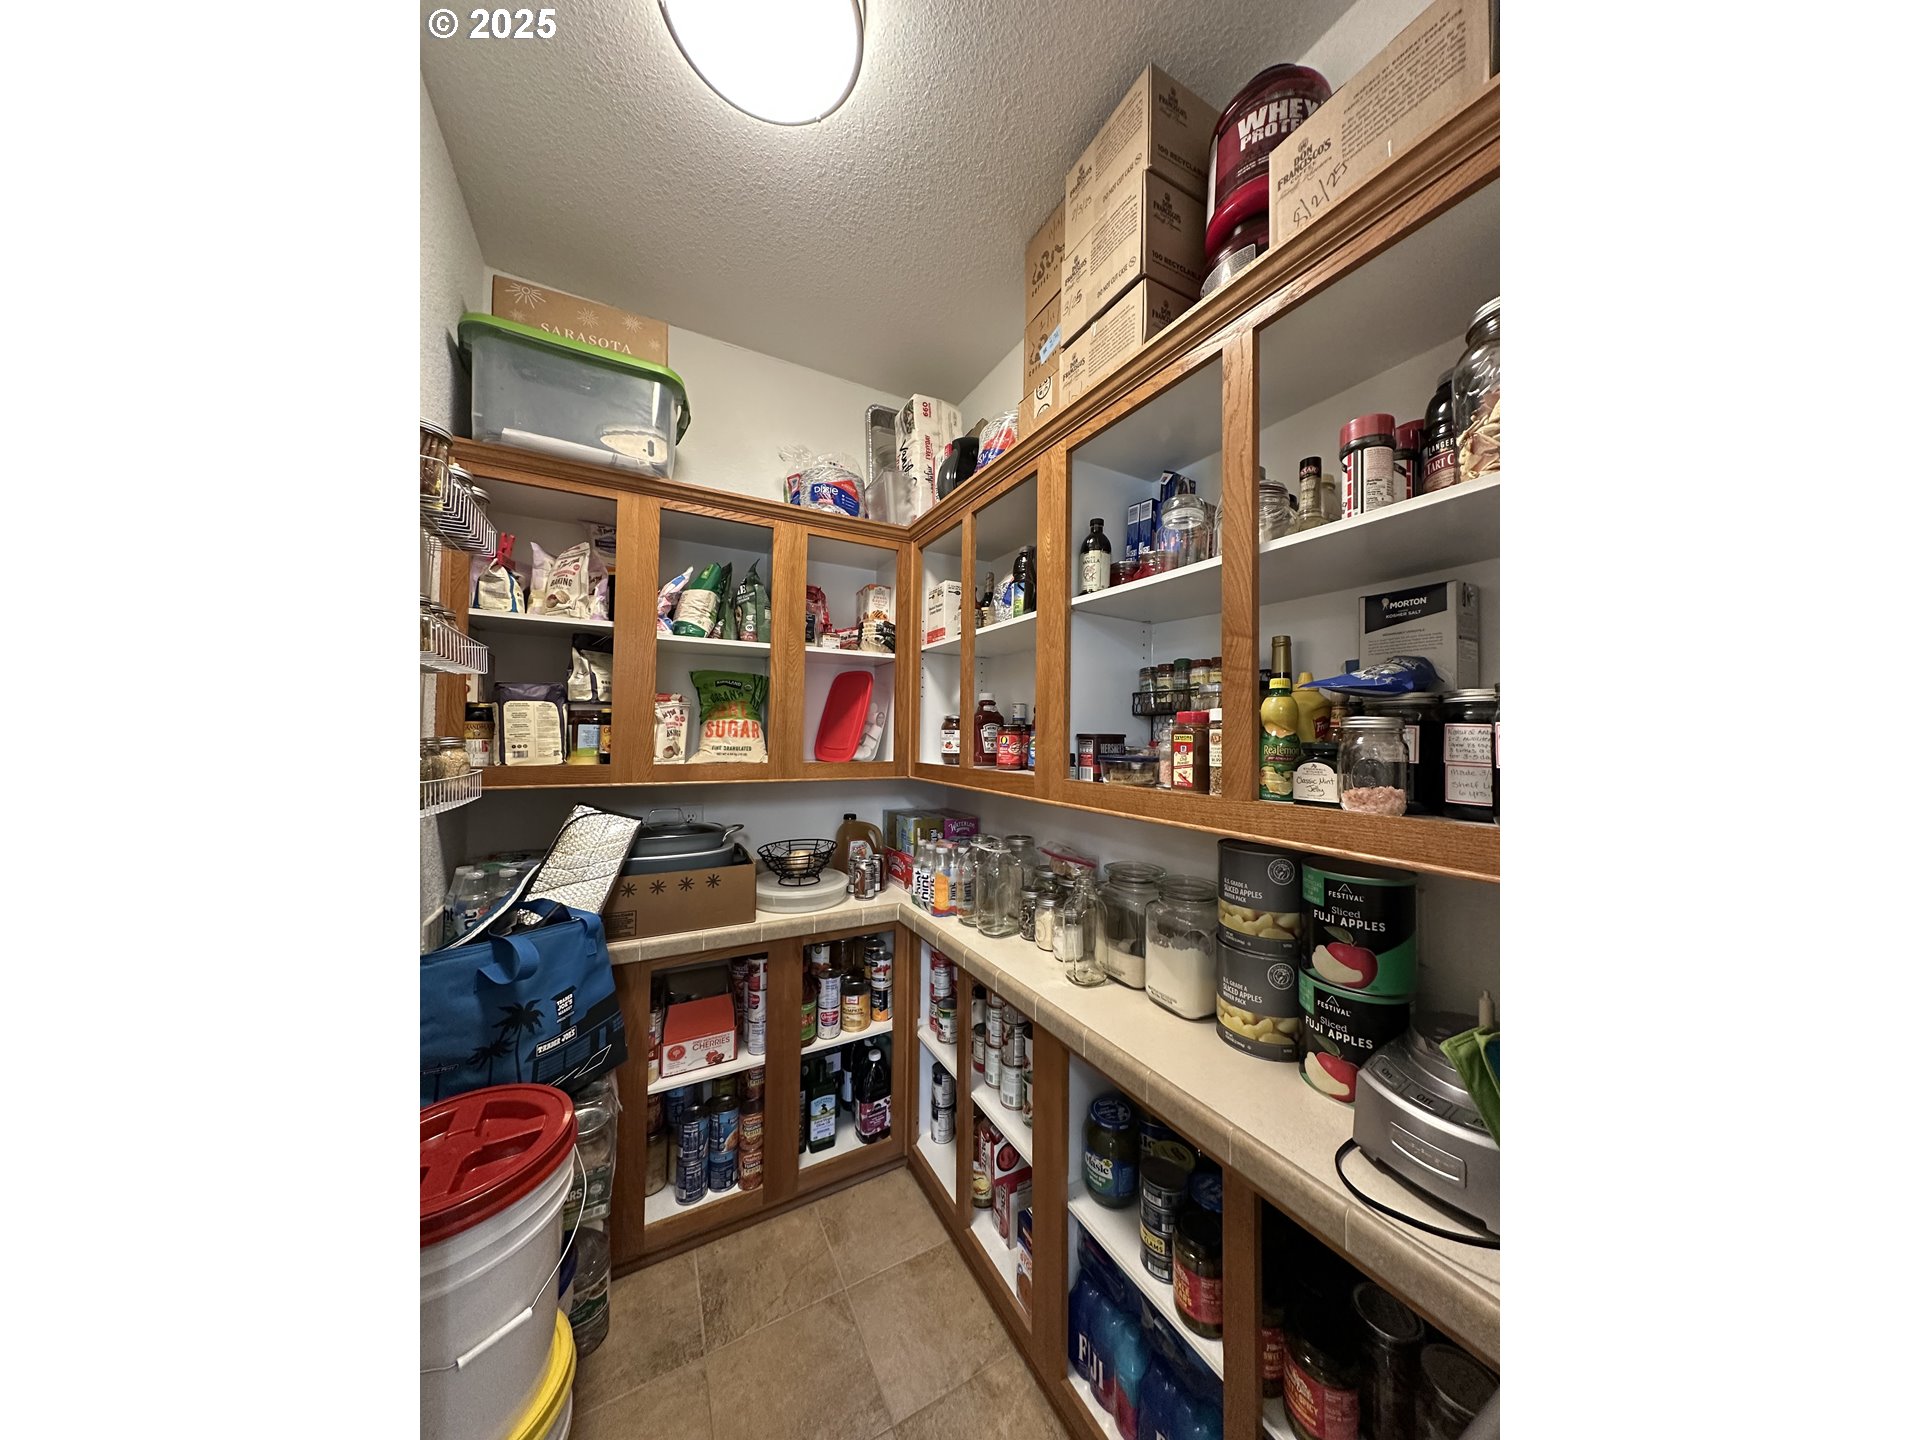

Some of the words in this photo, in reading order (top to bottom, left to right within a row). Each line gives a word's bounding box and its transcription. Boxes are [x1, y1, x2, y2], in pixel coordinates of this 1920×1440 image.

[1293, 144, 1313, 167] DON
[540, 321, 632, 355] SARASOTA
[1427, 457, 1446, 475] TART
[1389, 596, 1428, 610] MORTON
[1385, 611, 1407, 619] KOSHER
[705, 719, 760, 739] SUGAR
[921, 874, 930, 901] hint
[1239, 888, 1263, 900] APPLES
[1328, 889, 1365, 903] FESTIVAL
[1313, 908, 1335, 924] FUJI
[1340, 916, 1386, 932] APPLES
[1331, 905, 1362, 919] Sliced
[1229, 979, 1244, 991] GRADE
[556, 993, 573, 1006] TRADER
[1239, 990, 1263, 1004] APPLES
[1317, 999, 1351, 1017] FESTIVAL
[1305, 1014, 1324, 1034] FUJI
[1327, 1028, 1374, 1050] APPLES
[1319, 1015, 1348, 1034] Sliced
[538, 1037, 561, 1054] TRADER
[561, 1028, 576, 1042] JOE'S
[692, 1035, 731, 1051] CHERRIES
[1381, 1067, 1393, 1079] On
[1415, 1092, 1434, 1106] Off
[1078, 1332, 1104, 1391] FIJI
